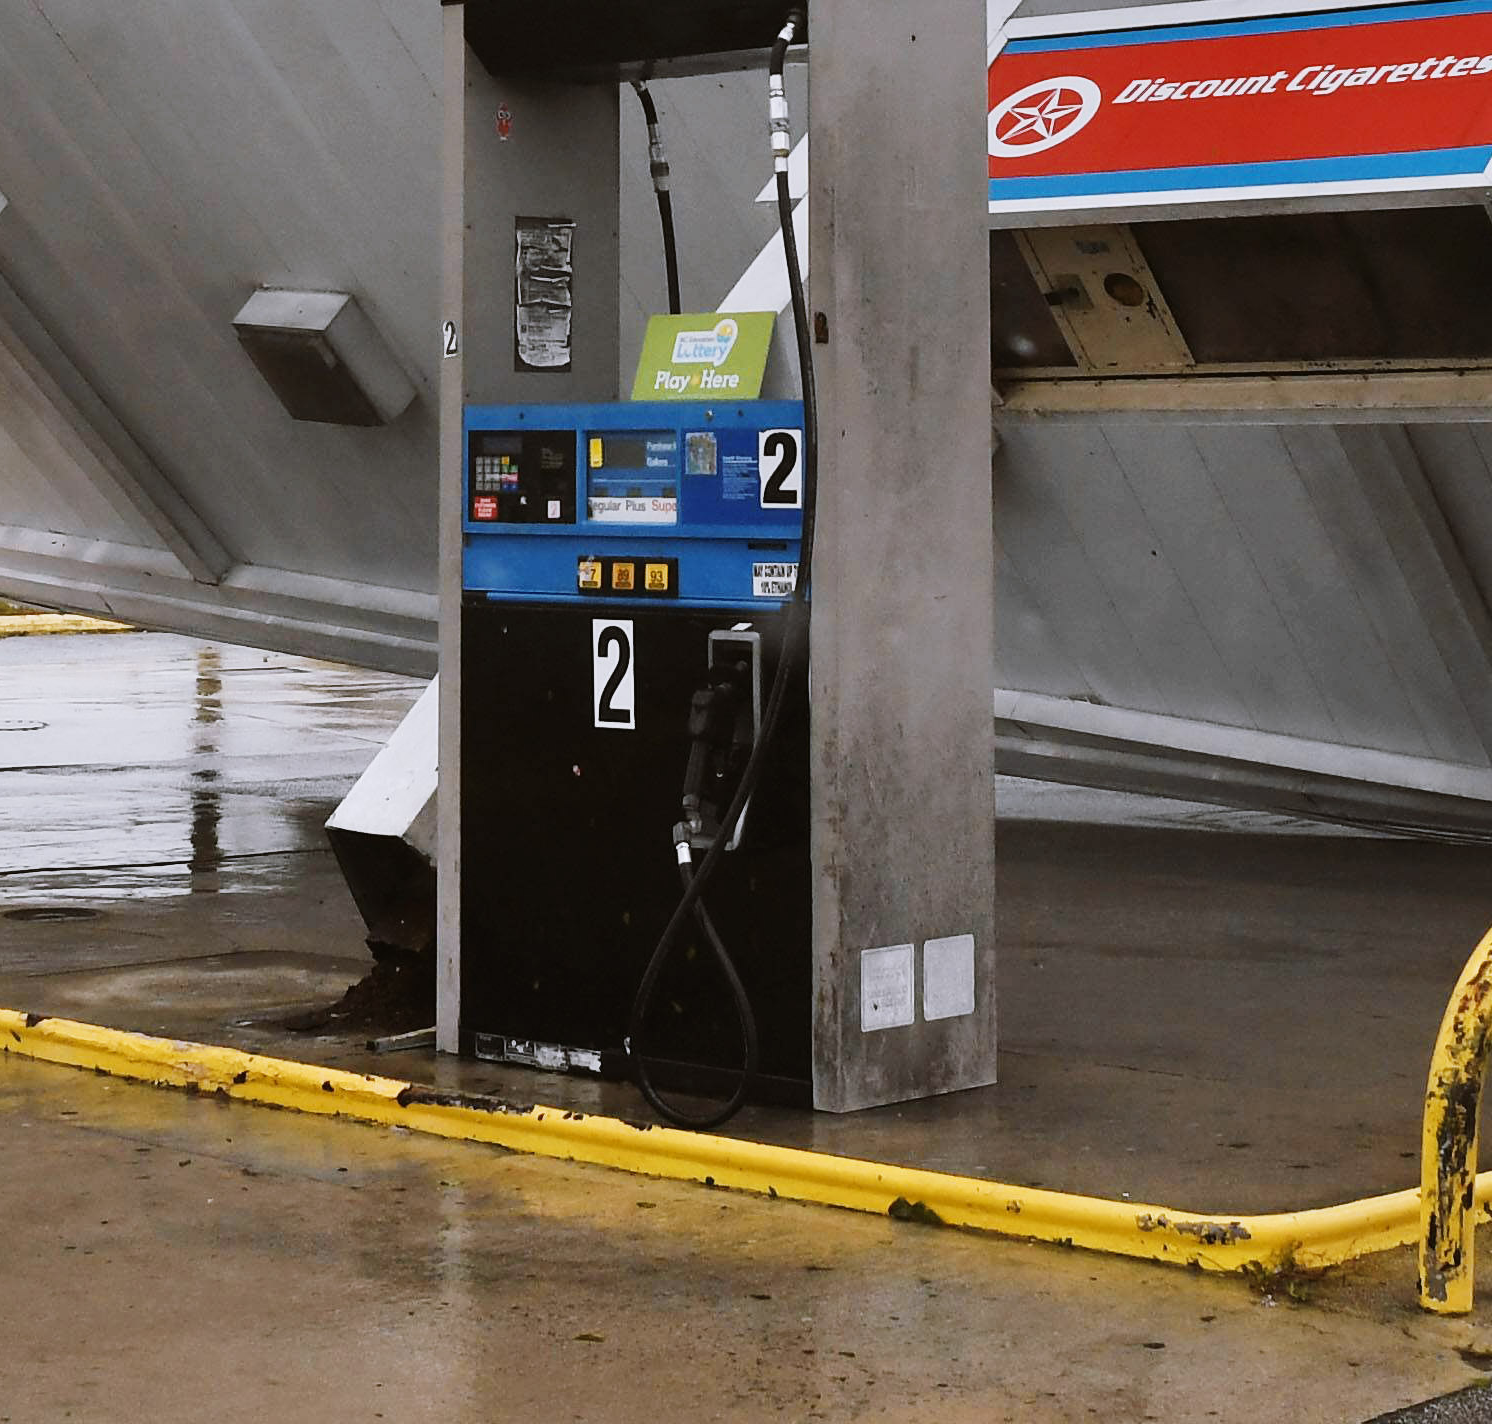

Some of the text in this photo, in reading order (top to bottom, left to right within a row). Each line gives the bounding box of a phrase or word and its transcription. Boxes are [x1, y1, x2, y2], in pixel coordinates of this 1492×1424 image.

[1112, 69, 1289, 104] Discount
[445, 321, 457, 355] 2
[654, 369, 739, 393] Play Here
[763, 432, 798, 504] 2
[625, 499, 646, 512] Plus
[650, 570, 663, 582] 93
[598, 626, 630, 723] 2
